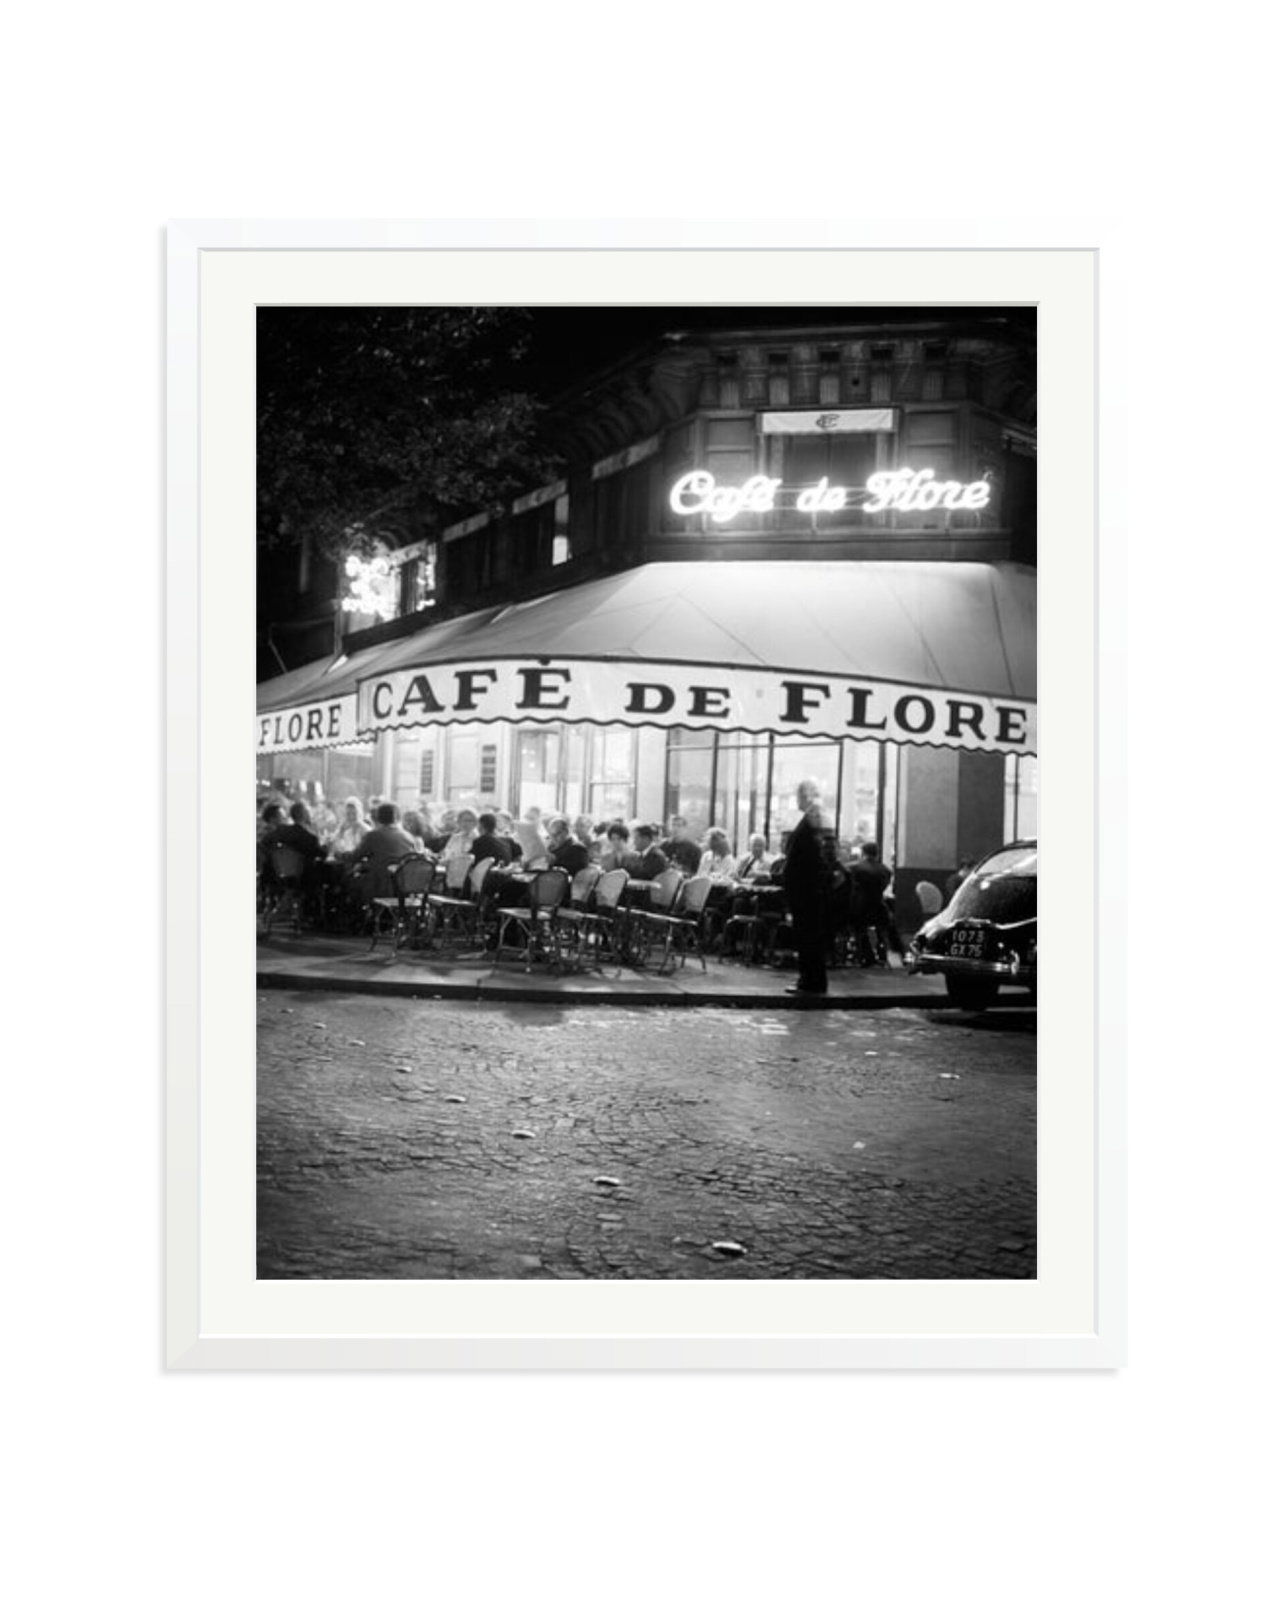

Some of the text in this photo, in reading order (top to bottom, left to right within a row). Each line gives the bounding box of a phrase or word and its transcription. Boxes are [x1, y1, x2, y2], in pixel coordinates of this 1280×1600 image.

[796, 476, 848, 513] de
[862, 466, 992, 513] Flore
[259, 703, 341, 746] FLORE
[624, 682, 731, 718] DE
[778, 680, 1028, 744] FLORE
